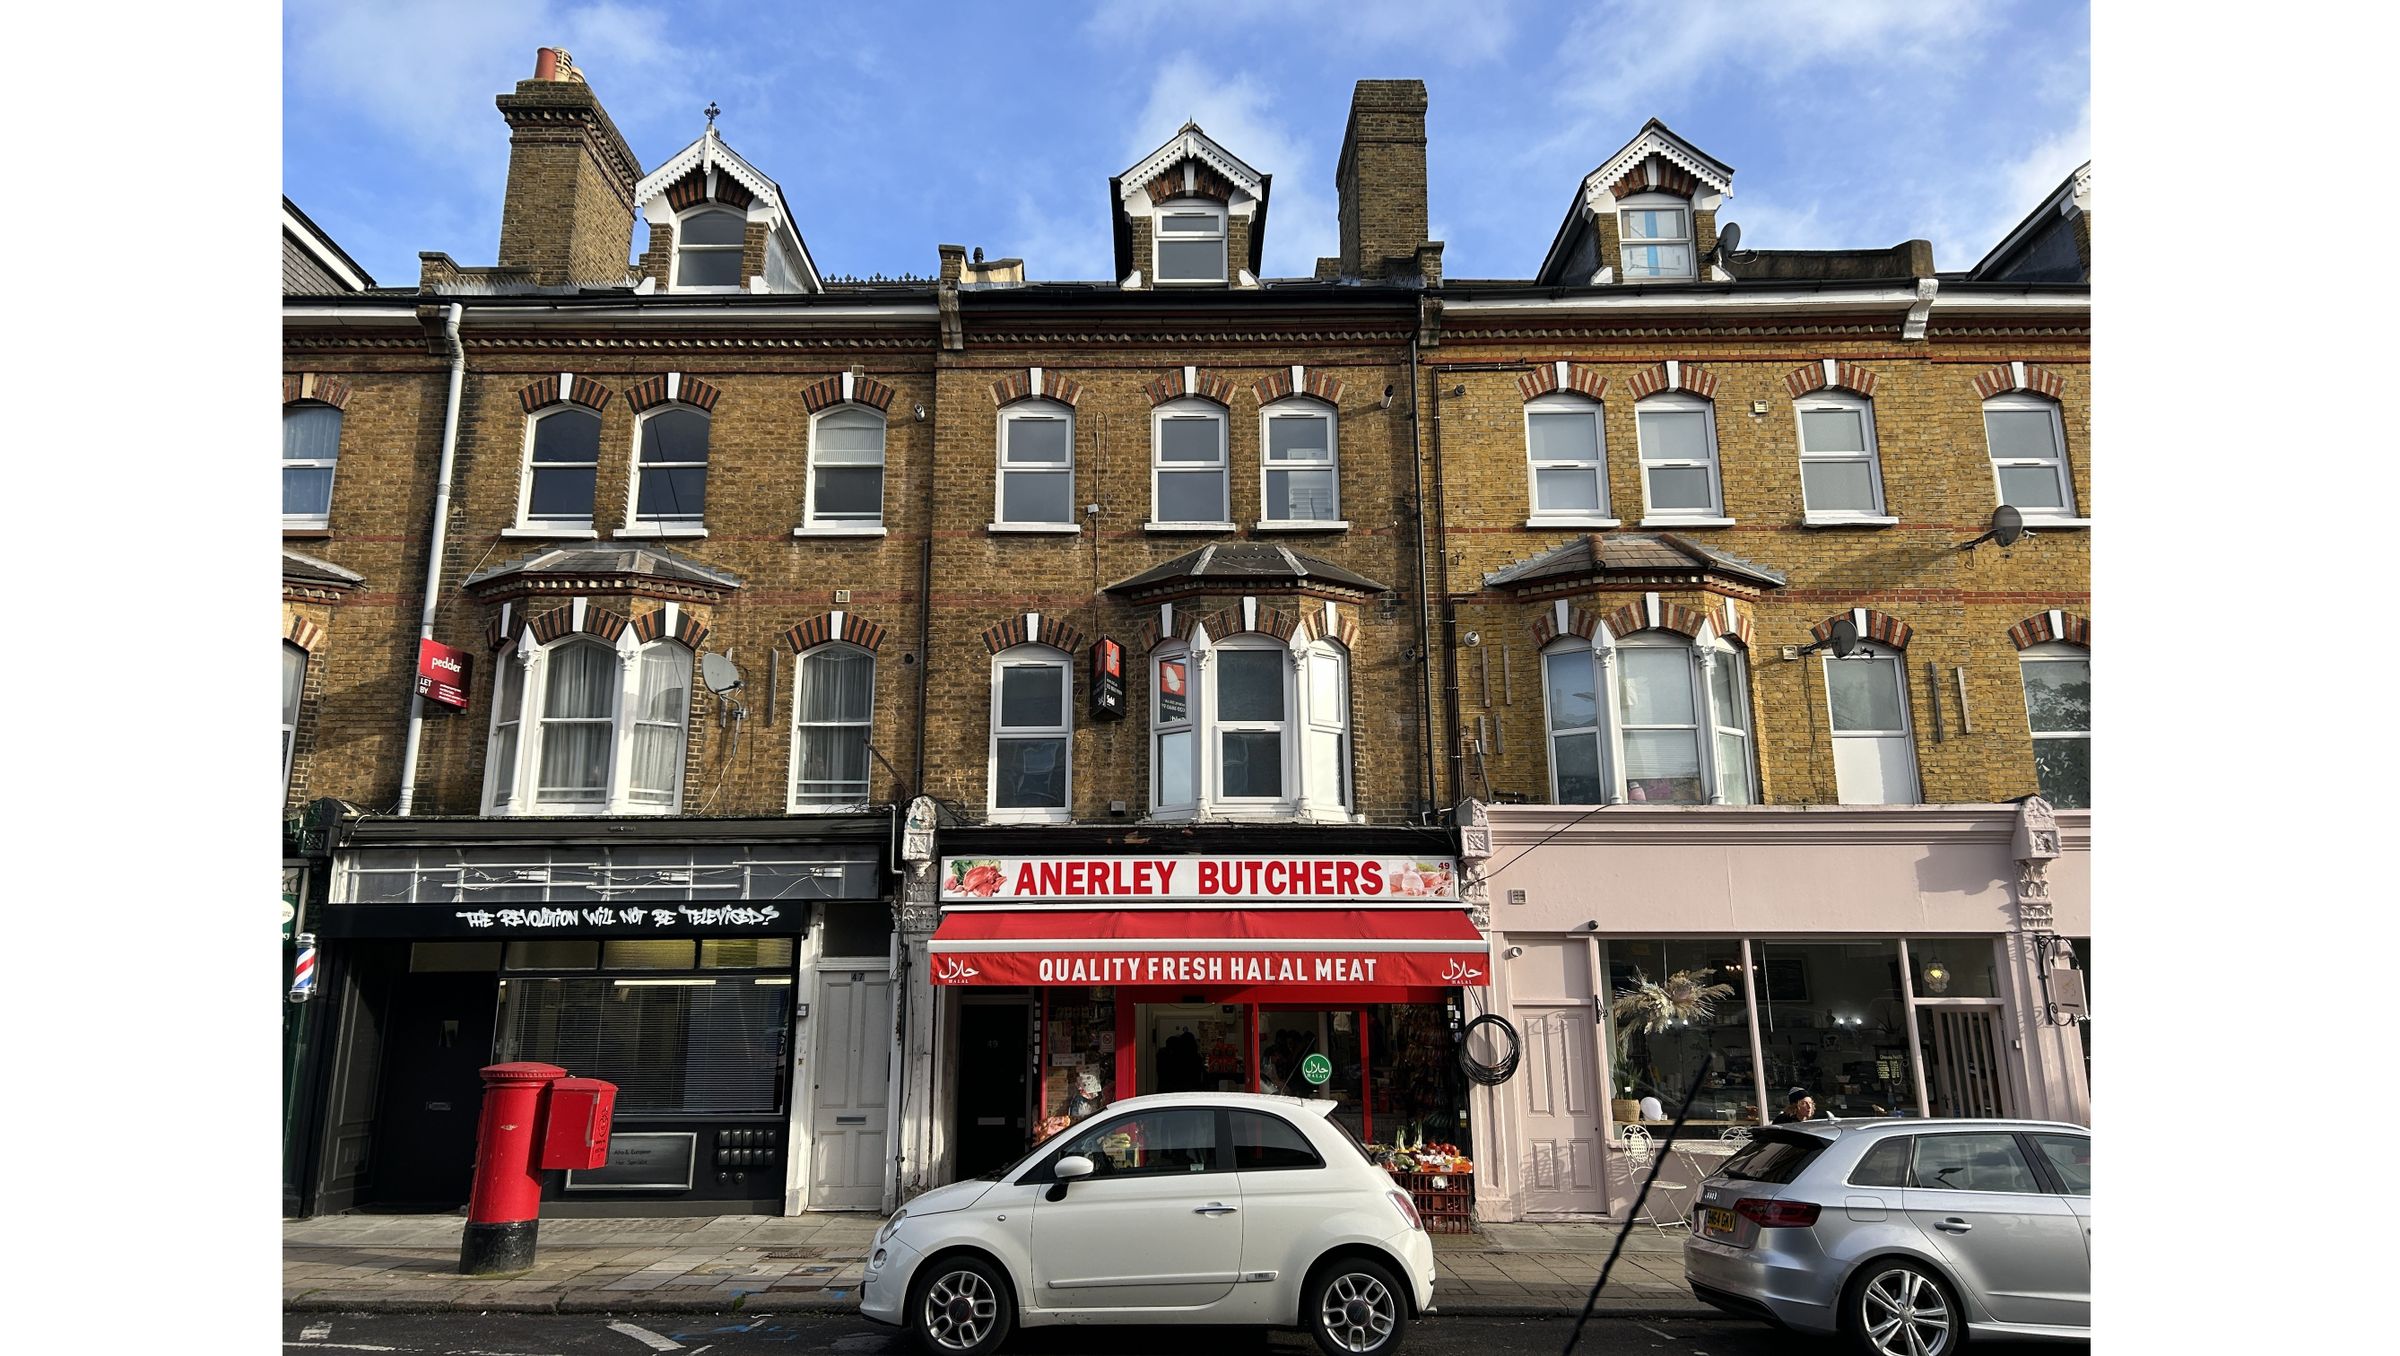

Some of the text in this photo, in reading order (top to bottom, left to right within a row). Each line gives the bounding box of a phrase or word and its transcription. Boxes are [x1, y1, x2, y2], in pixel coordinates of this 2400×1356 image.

[431, 657, 461, 672] pedder
[419, 678, 432, 687] LET
[419, 686, 429, 694] BY
[1438, 862, 1450, 870] 49
[1014, 860, 1383, 896] ANERLEY BUTCHERS
[456, 909, 495, 927] THE
[619, 906, 648, 925] NOT
[651, 908, 677, 928] BE
[939, 956, 980, 979] حلال
[1038, 957, 1377, 982] QUALITY FRESH HALAL MEAT
[1441, 957, 1483, 980] حلال
[1305, 1060, 1328, 1074] حلال
